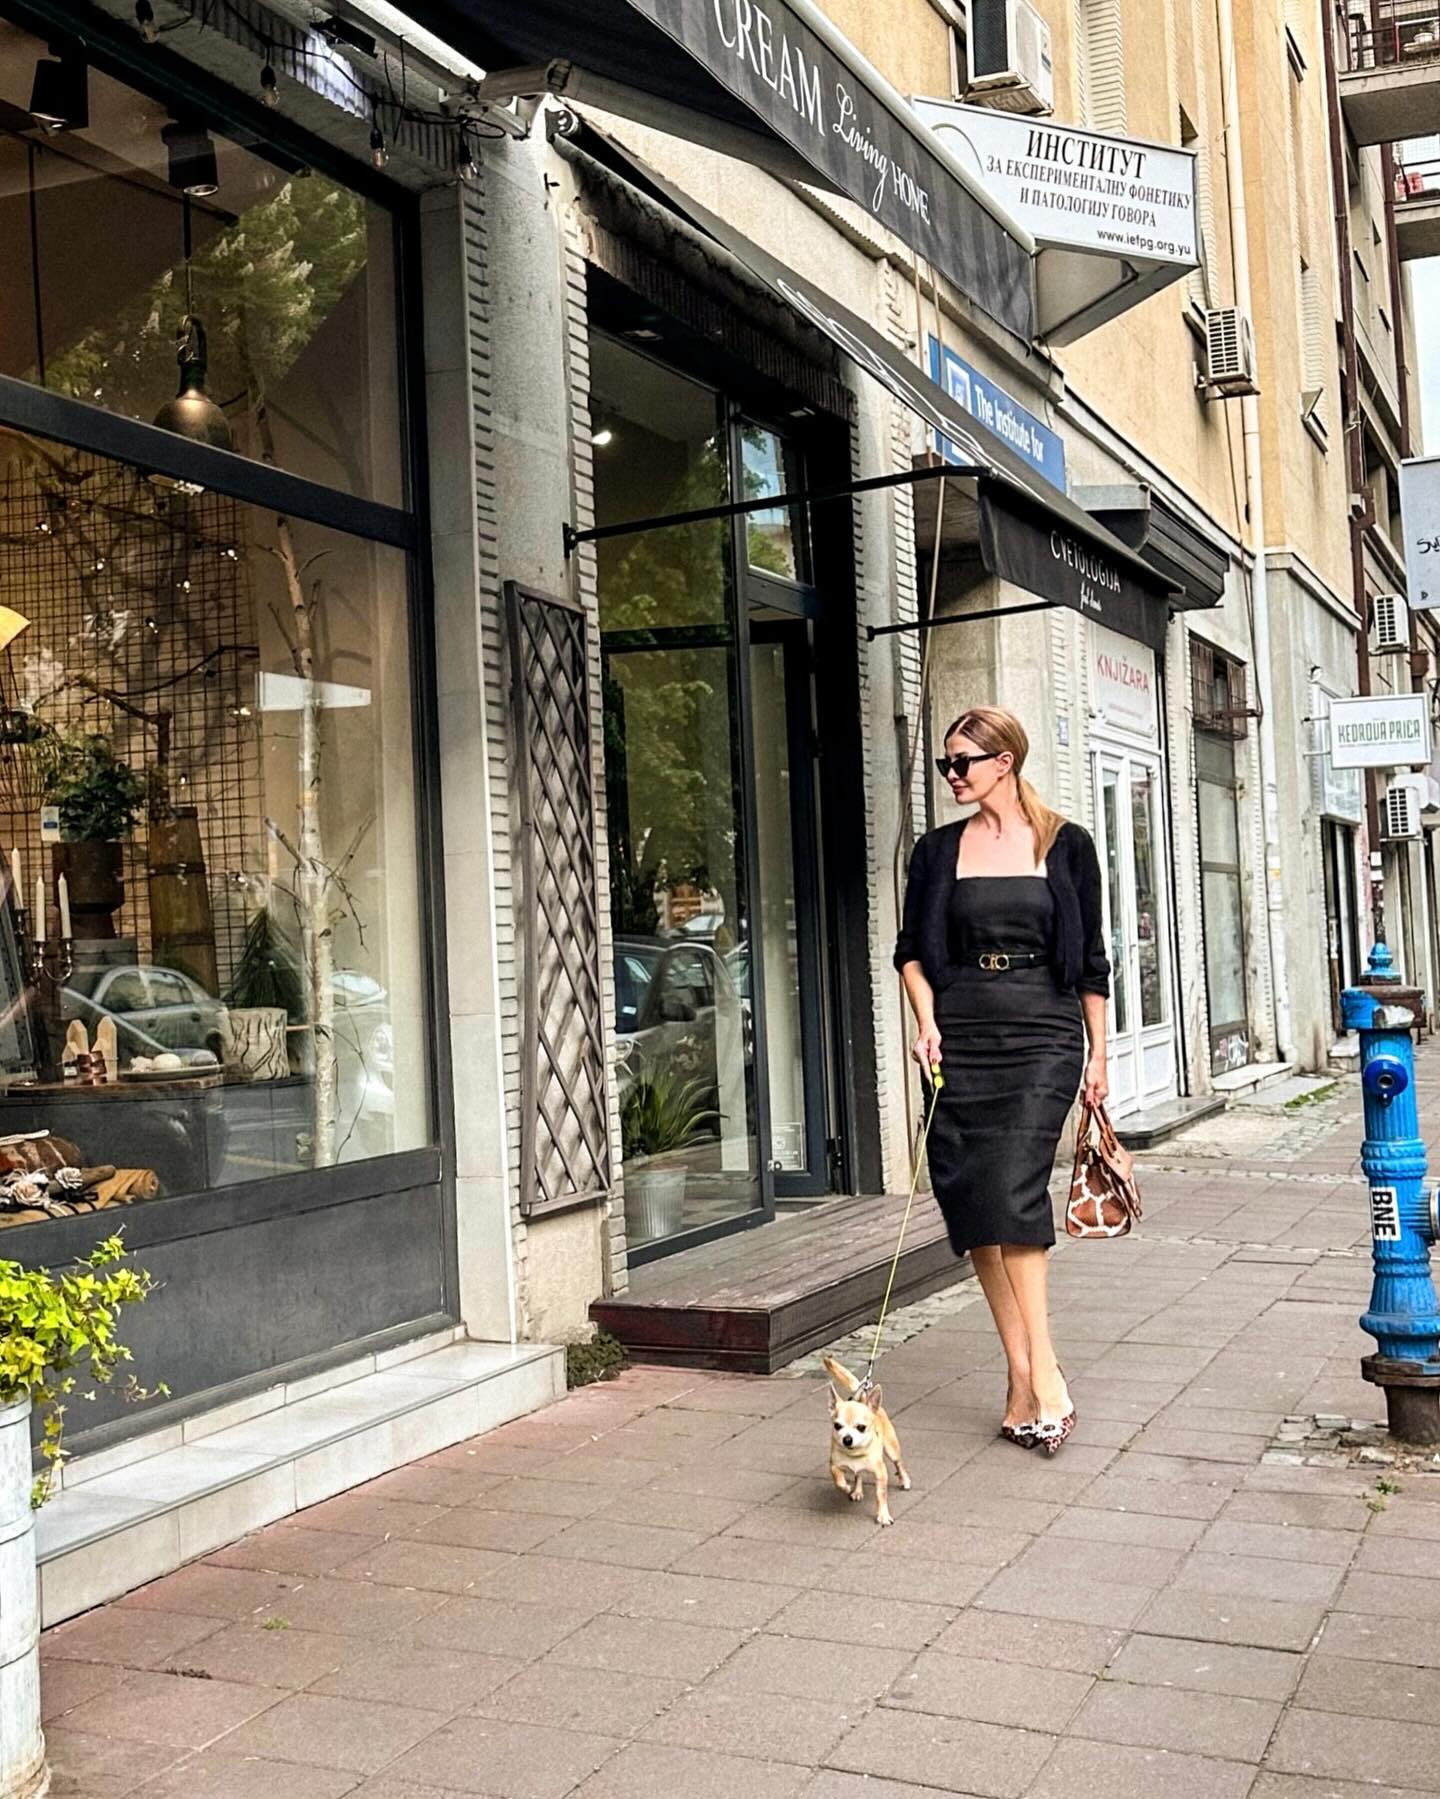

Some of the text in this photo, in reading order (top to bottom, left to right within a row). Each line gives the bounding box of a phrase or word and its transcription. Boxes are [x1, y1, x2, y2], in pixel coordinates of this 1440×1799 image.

[714, 0, 825, 136] CREAM
[832, 83, 888, 212] Living
[1025, 129, 1147, 179] ИНСТИТУТ
[986, 155, 1192, 210] ЗА ЕКСПЕРИМЕНТАЛНУ ФОНЕТИКУ
[1020, 187, 1157, 228] И ПАТОЛОГИЈУ ГОВОРА
[1096, 230, 1191, 257] www.iefpg.org.yu
[974, 384, 993, 426] The
[994, 399, 1031, 454] Institute
[1097, 653, 1150, 694] KNJIŽARA
[1372, 1191, 1396, 1236] BNE
